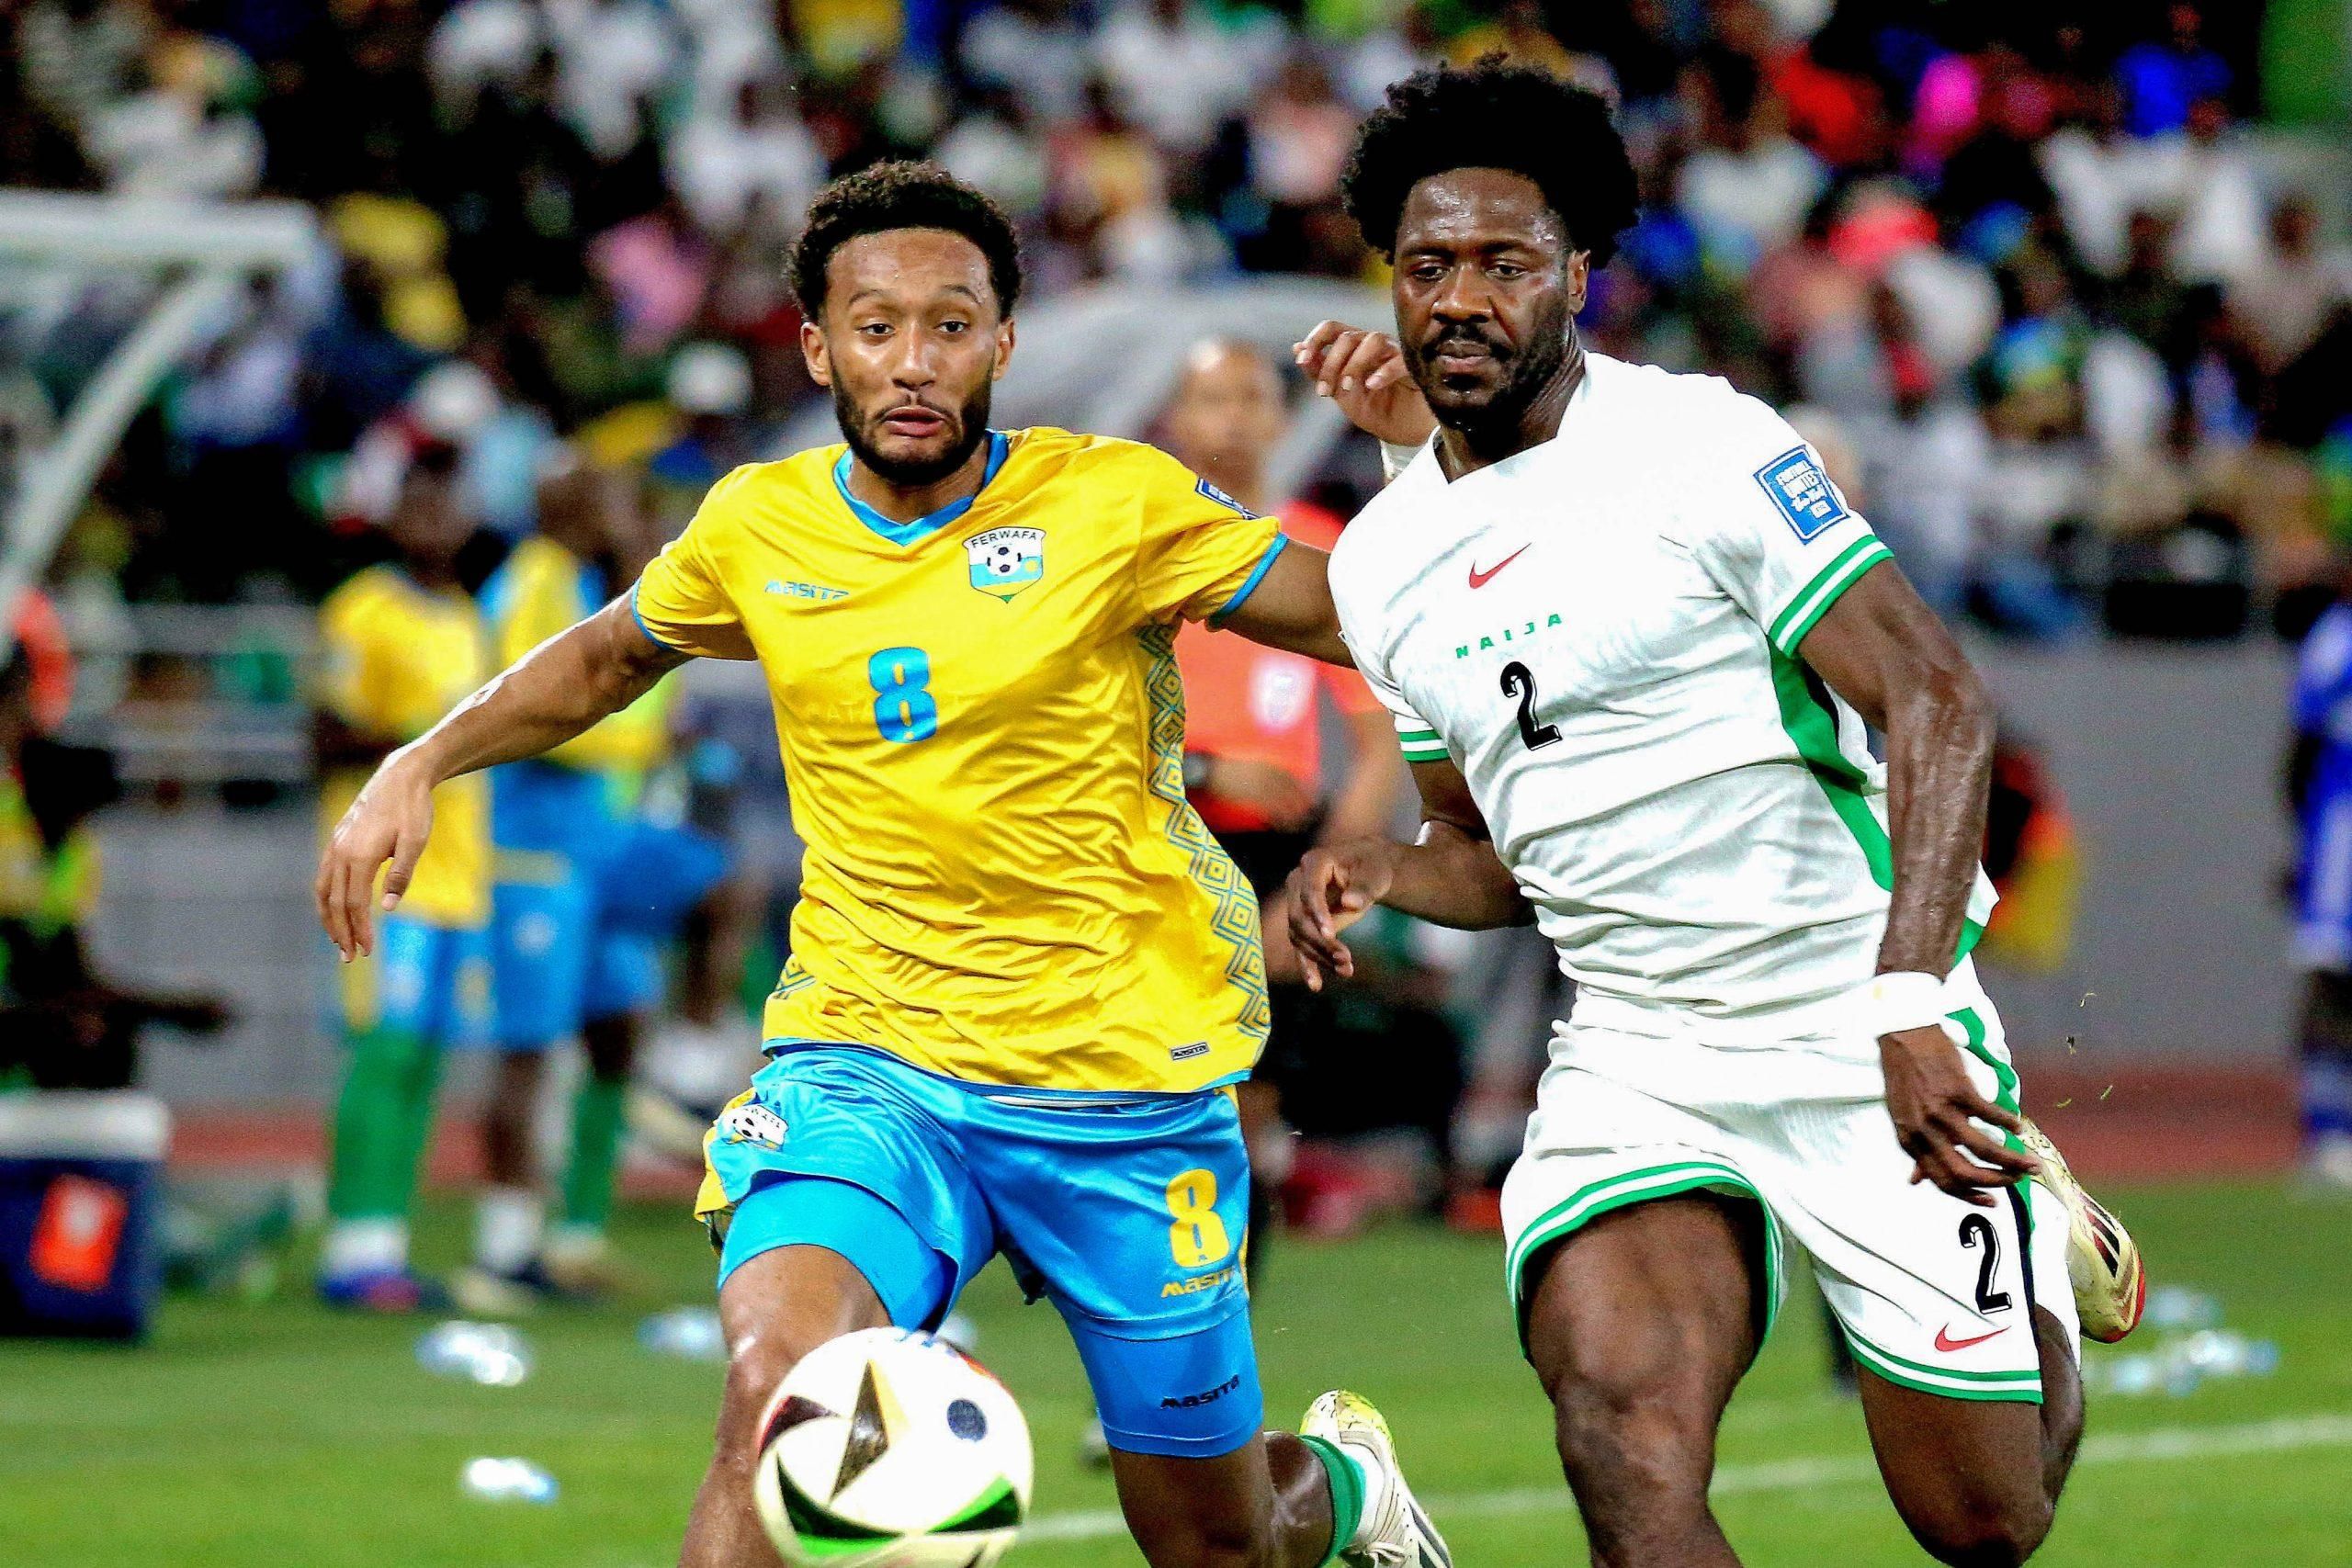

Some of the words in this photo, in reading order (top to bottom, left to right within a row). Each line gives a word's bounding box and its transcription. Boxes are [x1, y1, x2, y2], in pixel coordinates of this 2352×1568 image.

[970, 530, 1037, 548] FERWAFA
[1455, 614, 1563, 659] NAIJA
[868, 646, 938, 743] 8
[1499, 661, 1563, 751] 2
[1165, 1168, 1230, 1268] 8
[1959, 1213, 2013, 1315] 2
